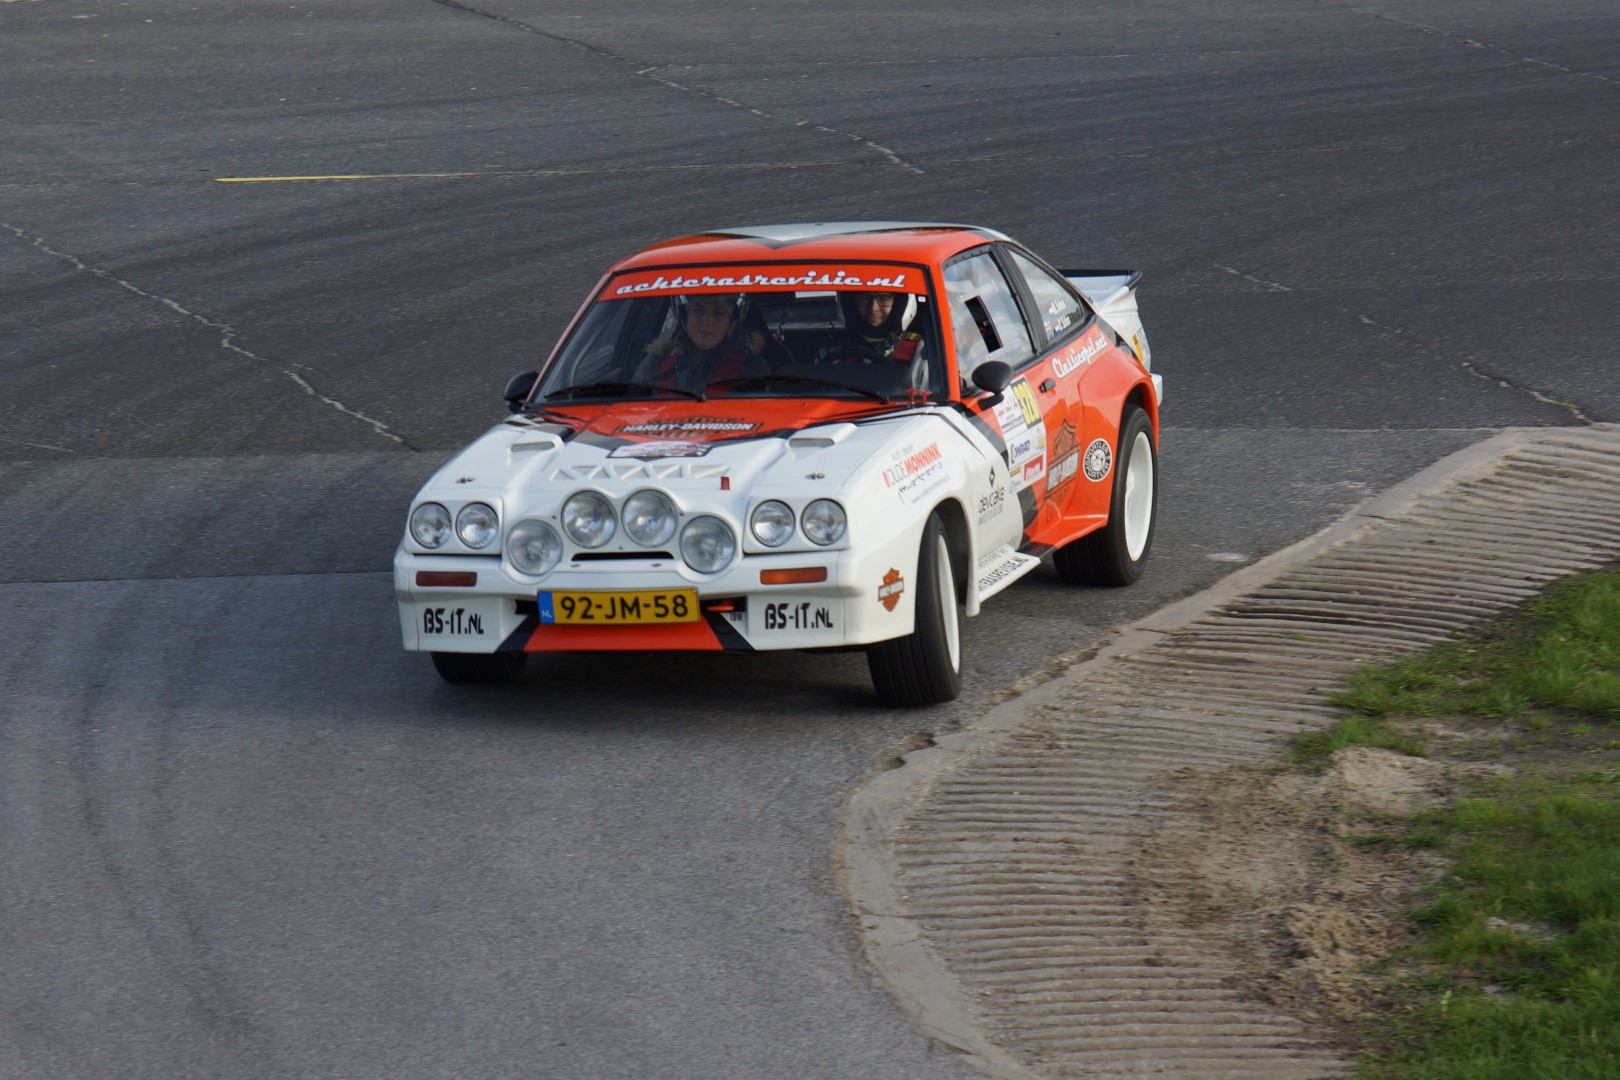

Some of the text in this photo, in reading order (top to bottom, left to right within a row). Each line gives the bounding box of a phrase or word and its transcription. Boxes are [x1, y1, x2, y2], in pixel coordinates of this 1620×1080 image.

[616, 270, 905, 295] achterasrevisie.nl
[623, 423, 754, 432] HARLEY-DAVIDSON
[541, 610, 553, 618] NL
[560, 594, 689, 620] 92-JM-58
[764, 602, 834, 630] BS-IT.NL
[423, 607, 485, 635] BS-IT.NL
